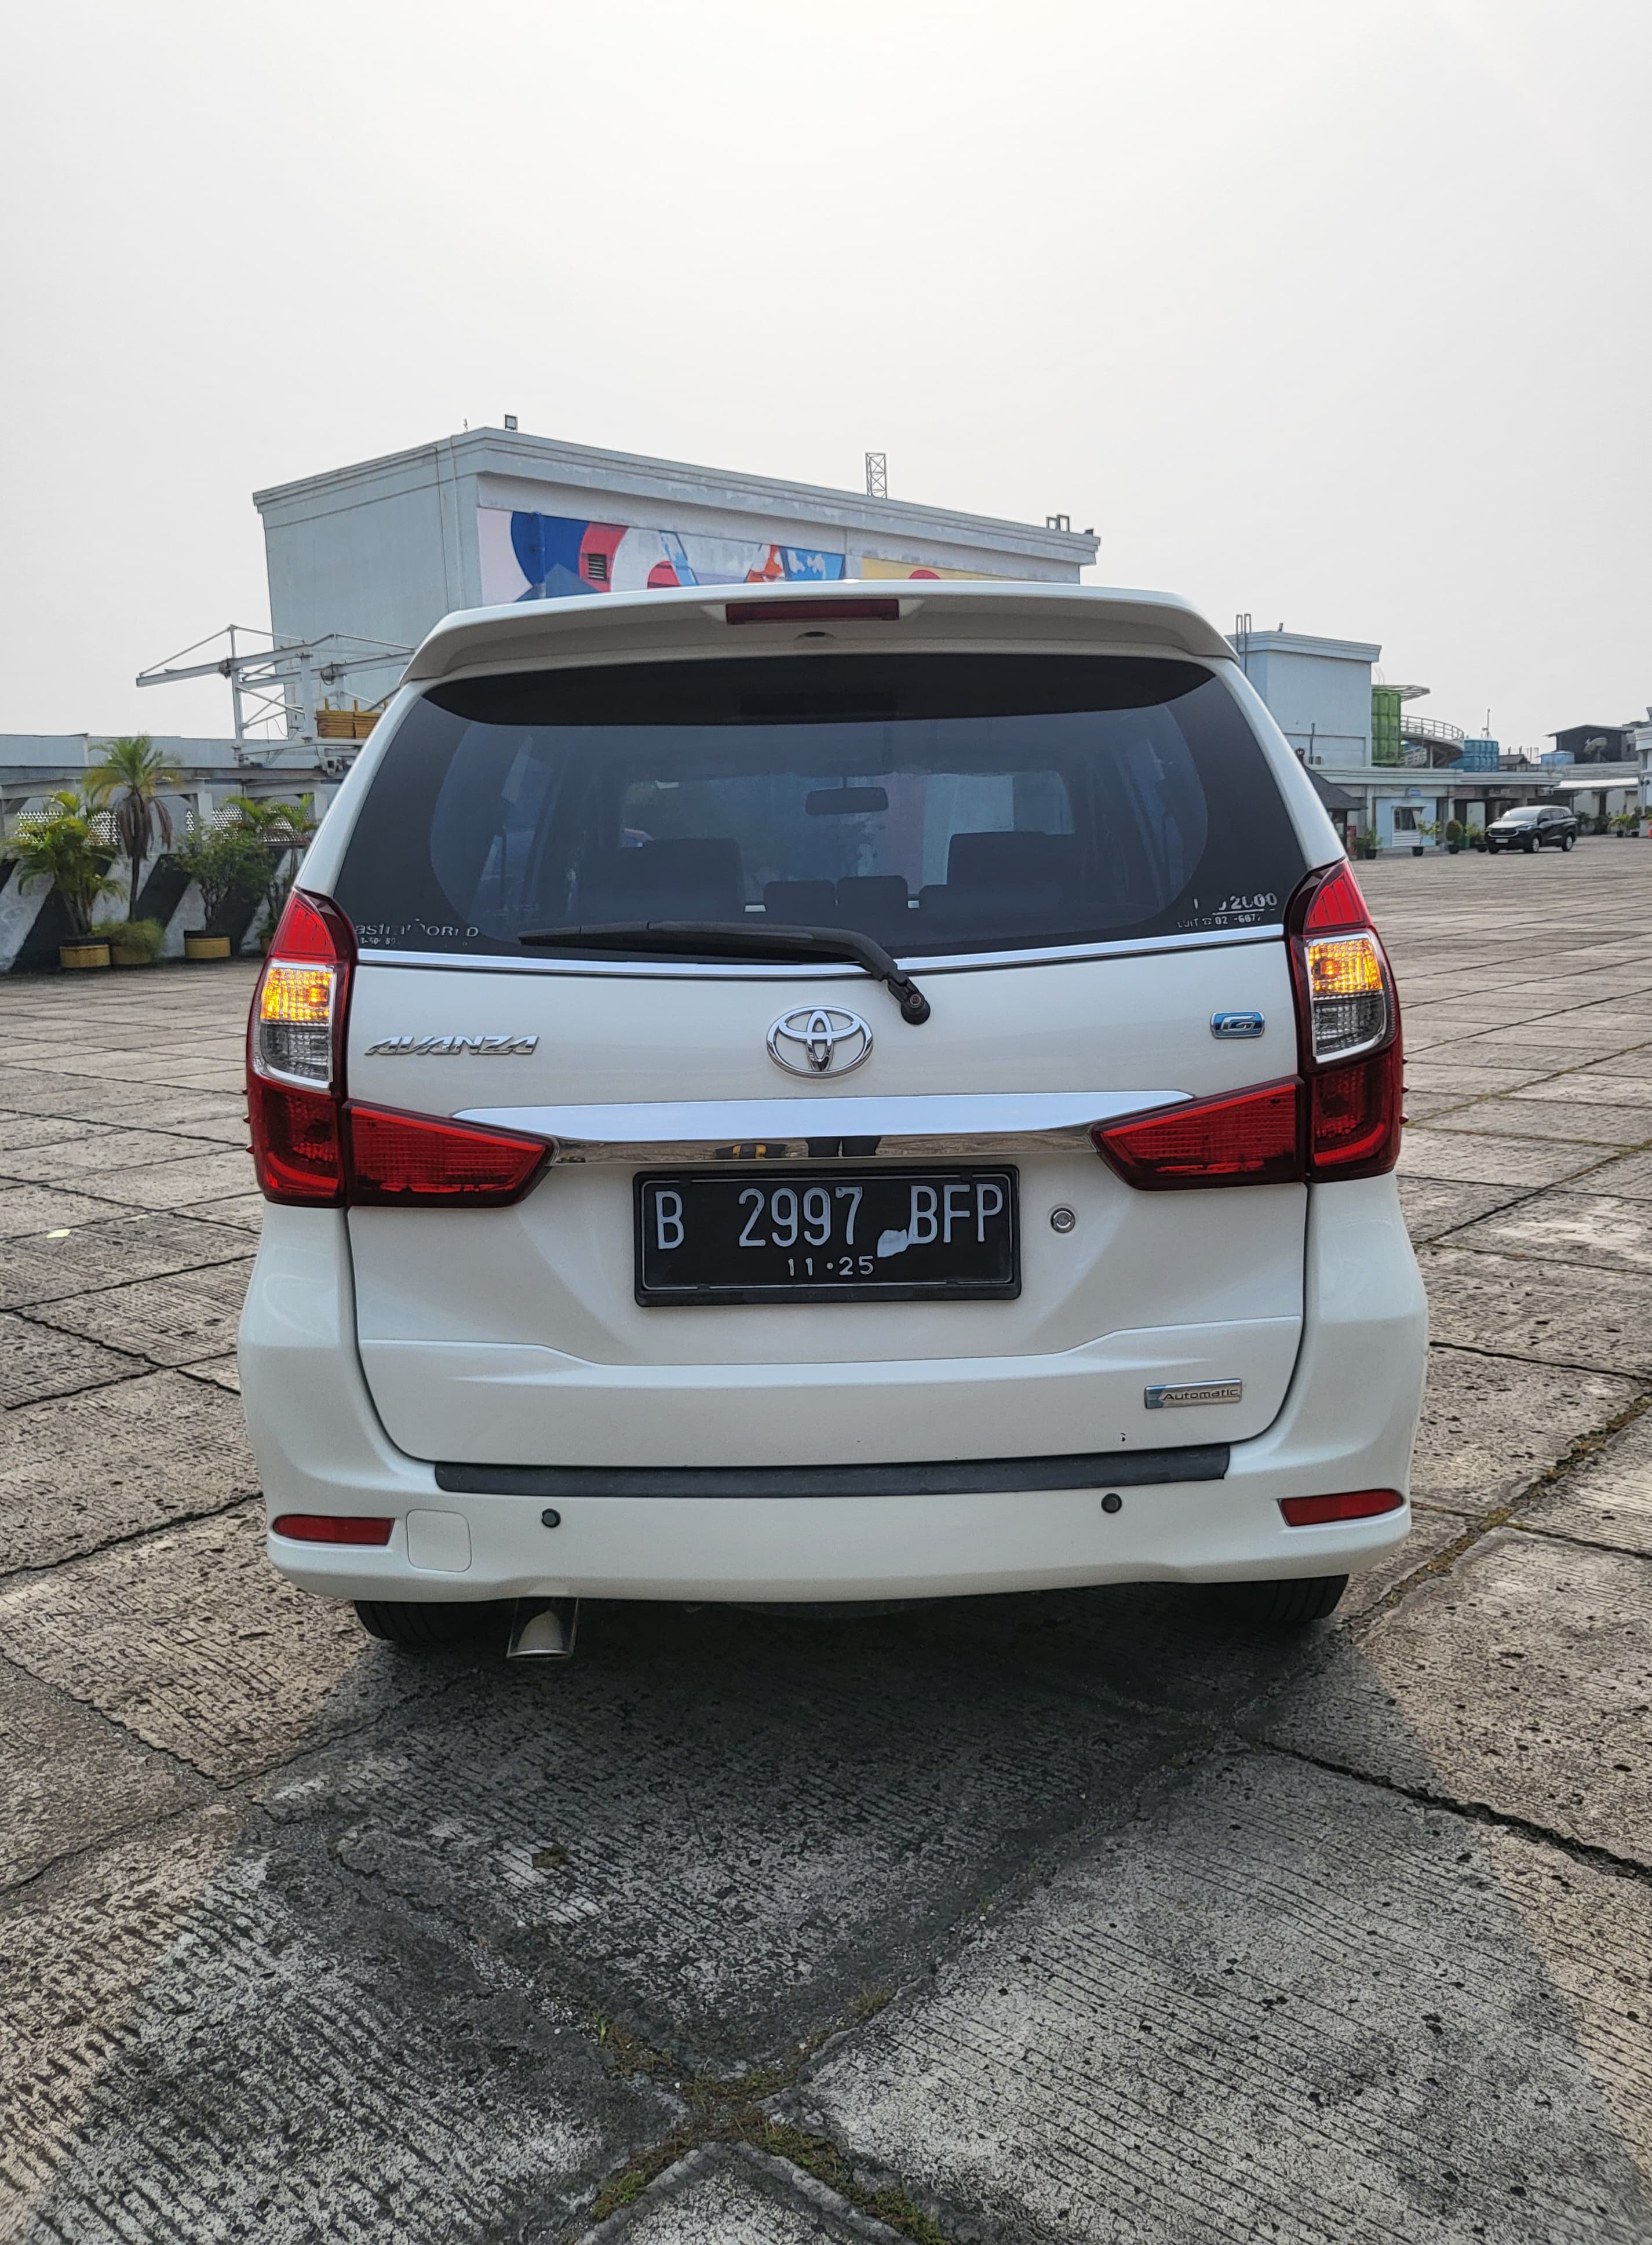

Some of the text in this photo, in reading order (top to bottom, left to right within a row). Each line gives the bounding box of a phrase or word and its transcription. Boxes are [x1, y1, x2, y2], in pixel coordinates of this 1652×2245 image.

[364, 1035, 539, 1055] AVANZA
[655, 1183, 1003, 1250] B 2997 BFP
[1163, 1388, 1239, 1401] Automatic
